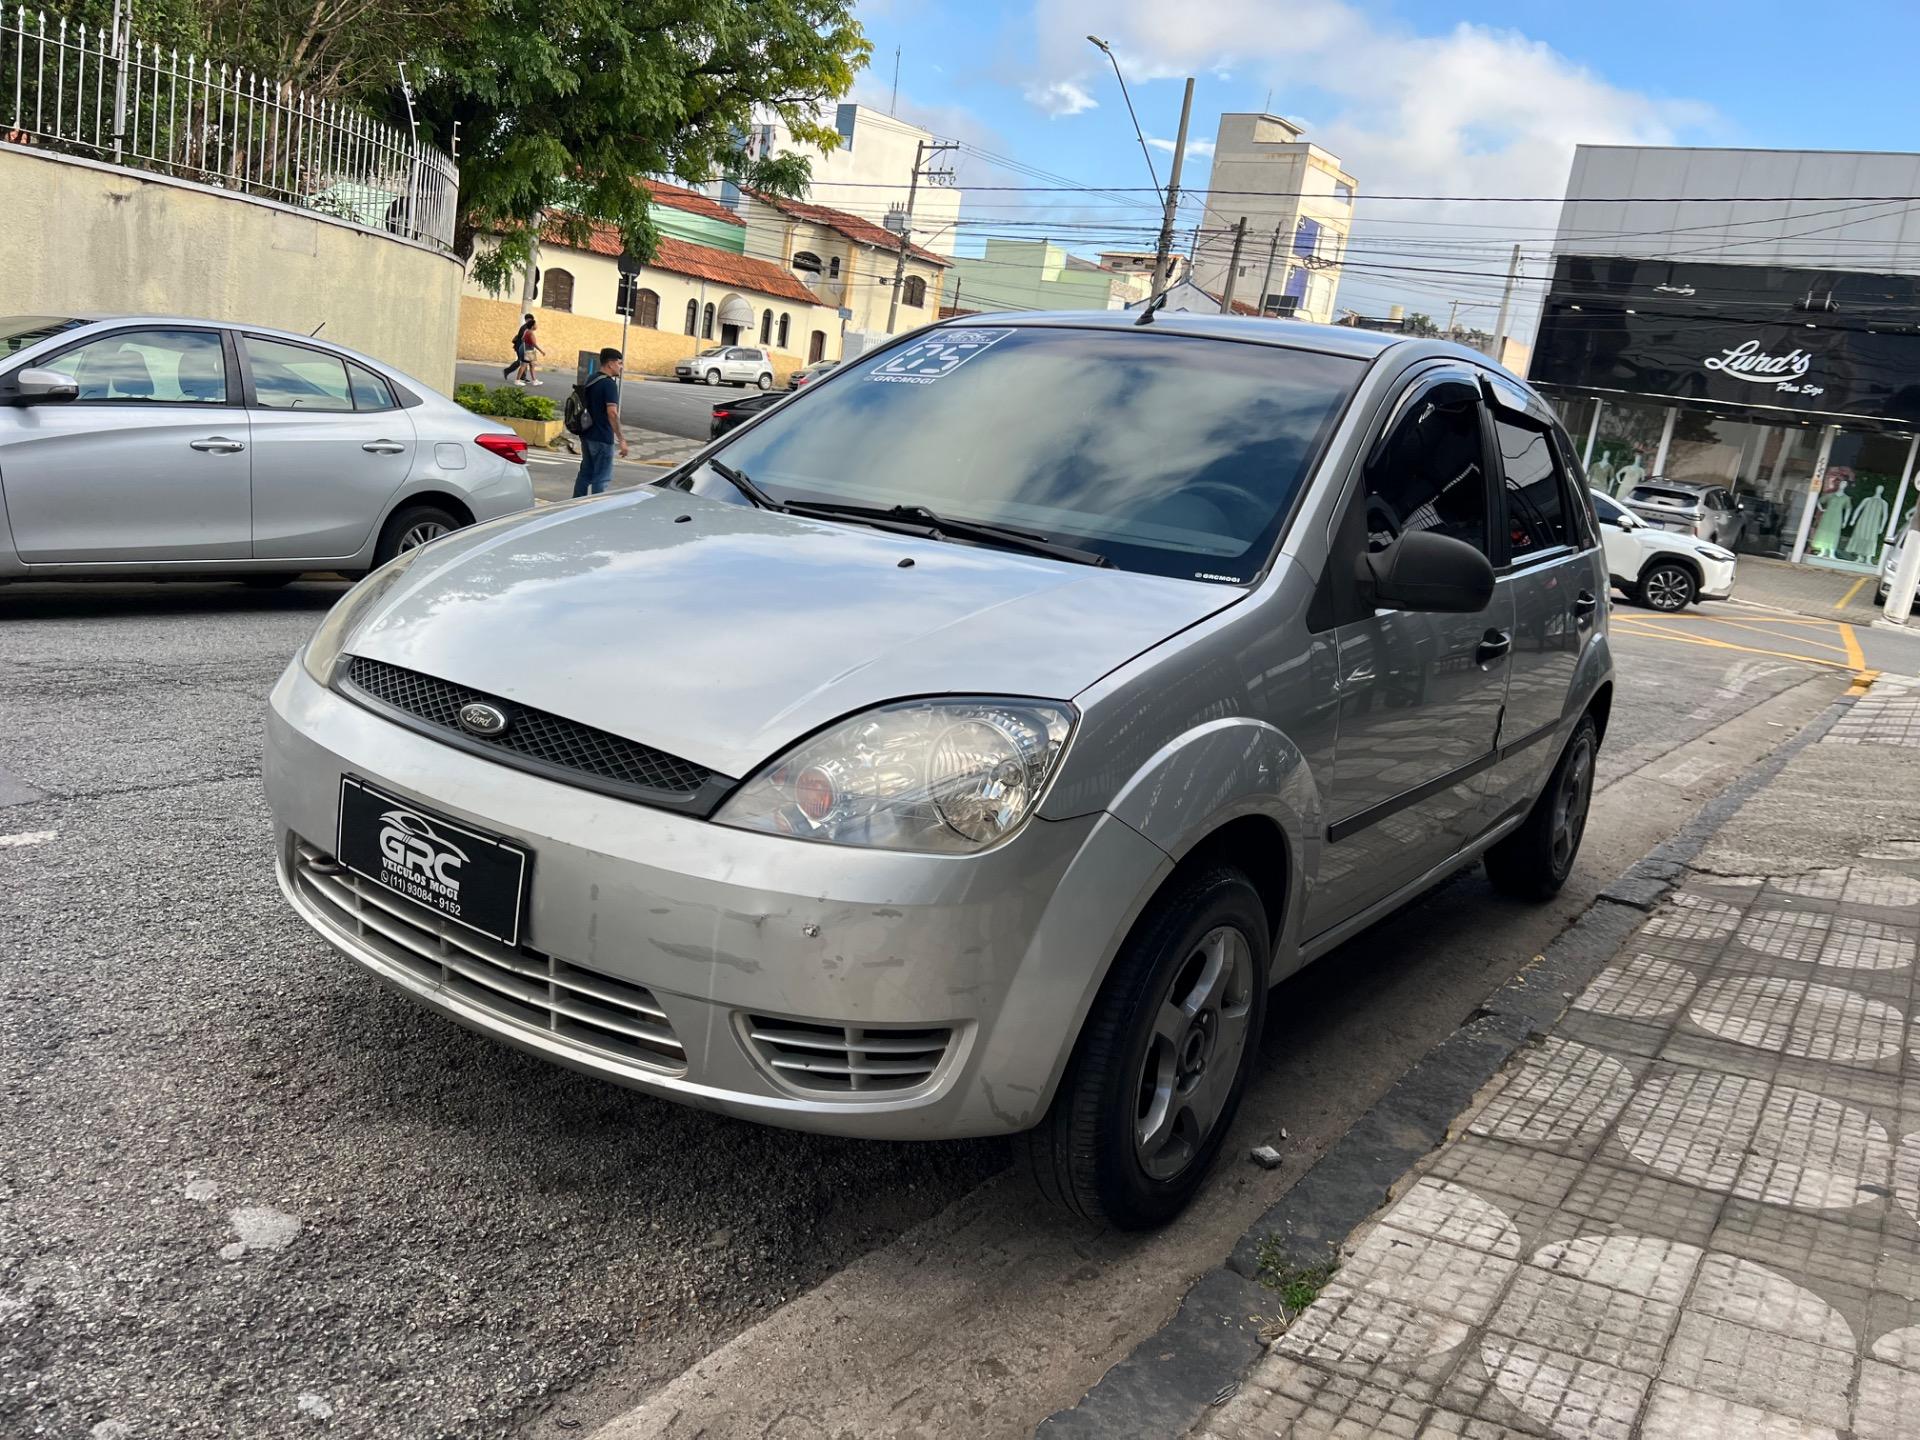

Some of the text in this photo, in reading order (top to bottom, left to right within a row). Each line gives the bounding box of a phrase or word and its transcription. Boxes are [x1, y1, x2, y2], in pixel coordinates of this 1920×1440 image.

[886, 344, 979, 374] 05
[1704, 340, 1812, 382] Lurd's
[466, 708, 493, 727] Ford
[380, 826, 461, 891] GRC
[382, 856, 458, 901] VEICULOS MOGI
[390, 873, 406, 892] (11)
